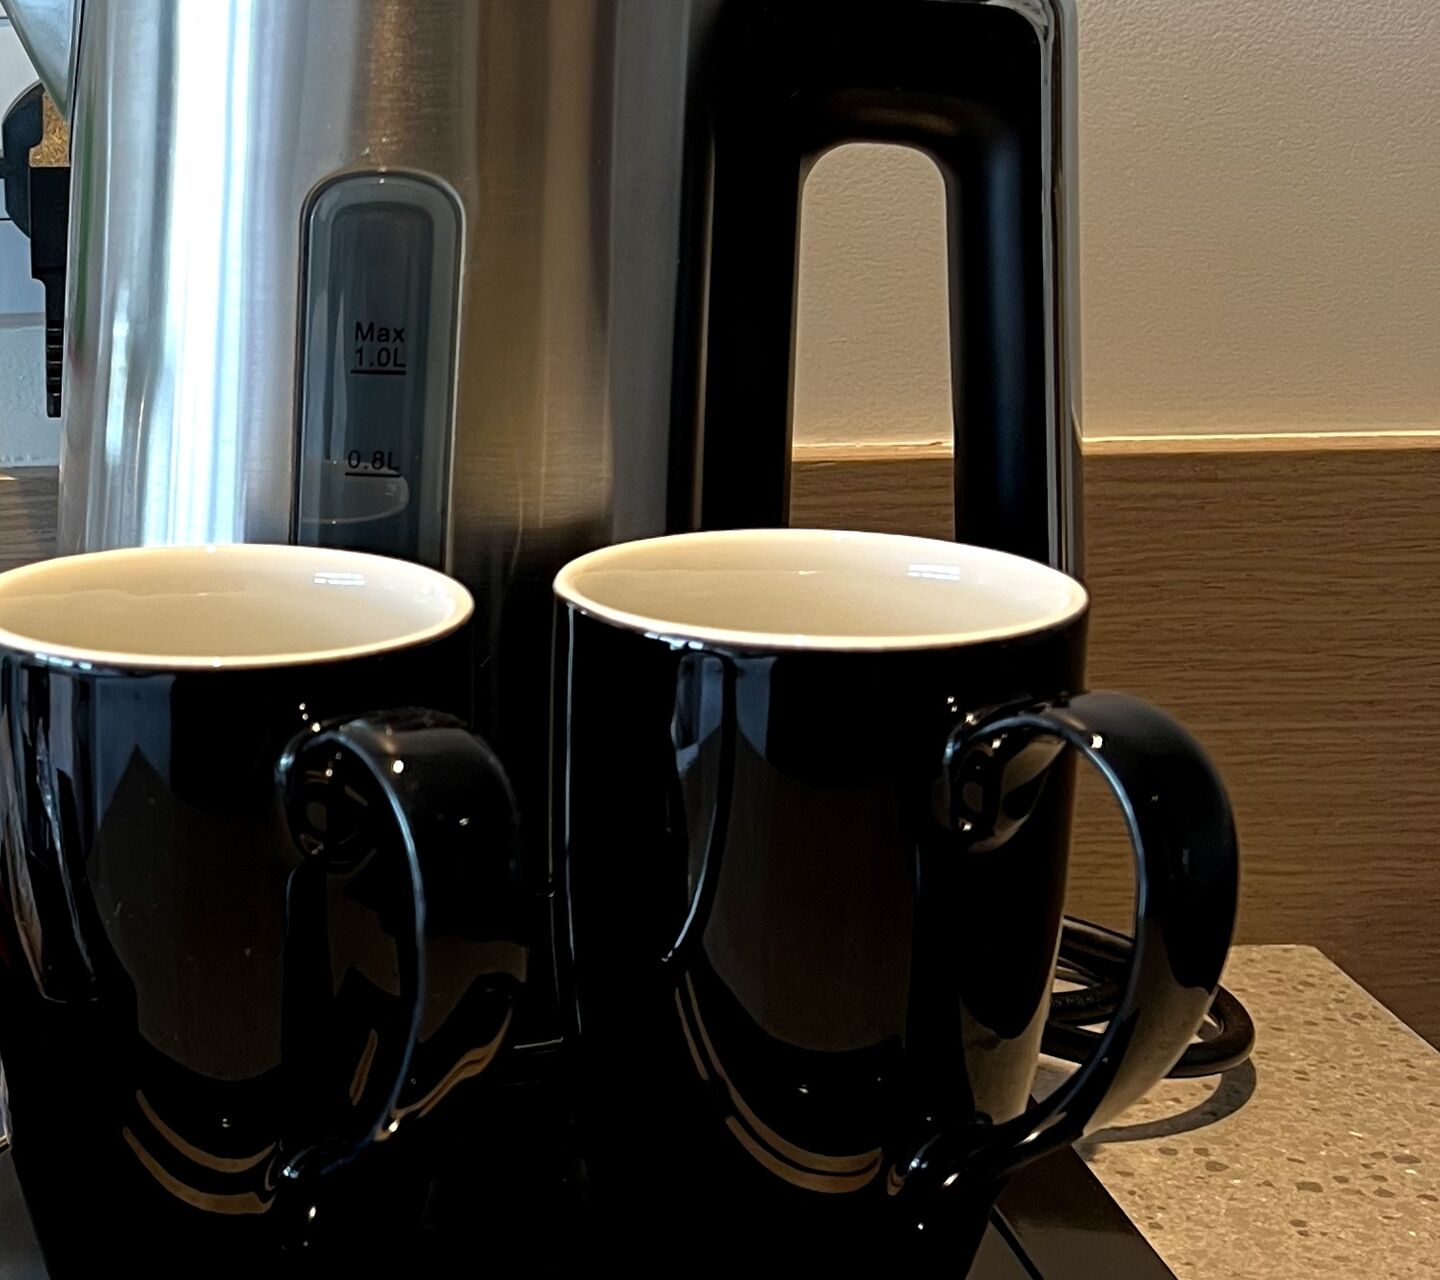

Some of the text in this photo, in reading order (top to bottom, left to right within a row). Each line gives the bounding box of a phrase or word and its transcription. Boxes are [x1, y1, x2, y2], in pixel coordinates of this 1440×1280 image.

[355, 321, 406, 345] Max
[355, 346, 406, 368] 1.0L
[347, 449, 401, 471] 0.8L
